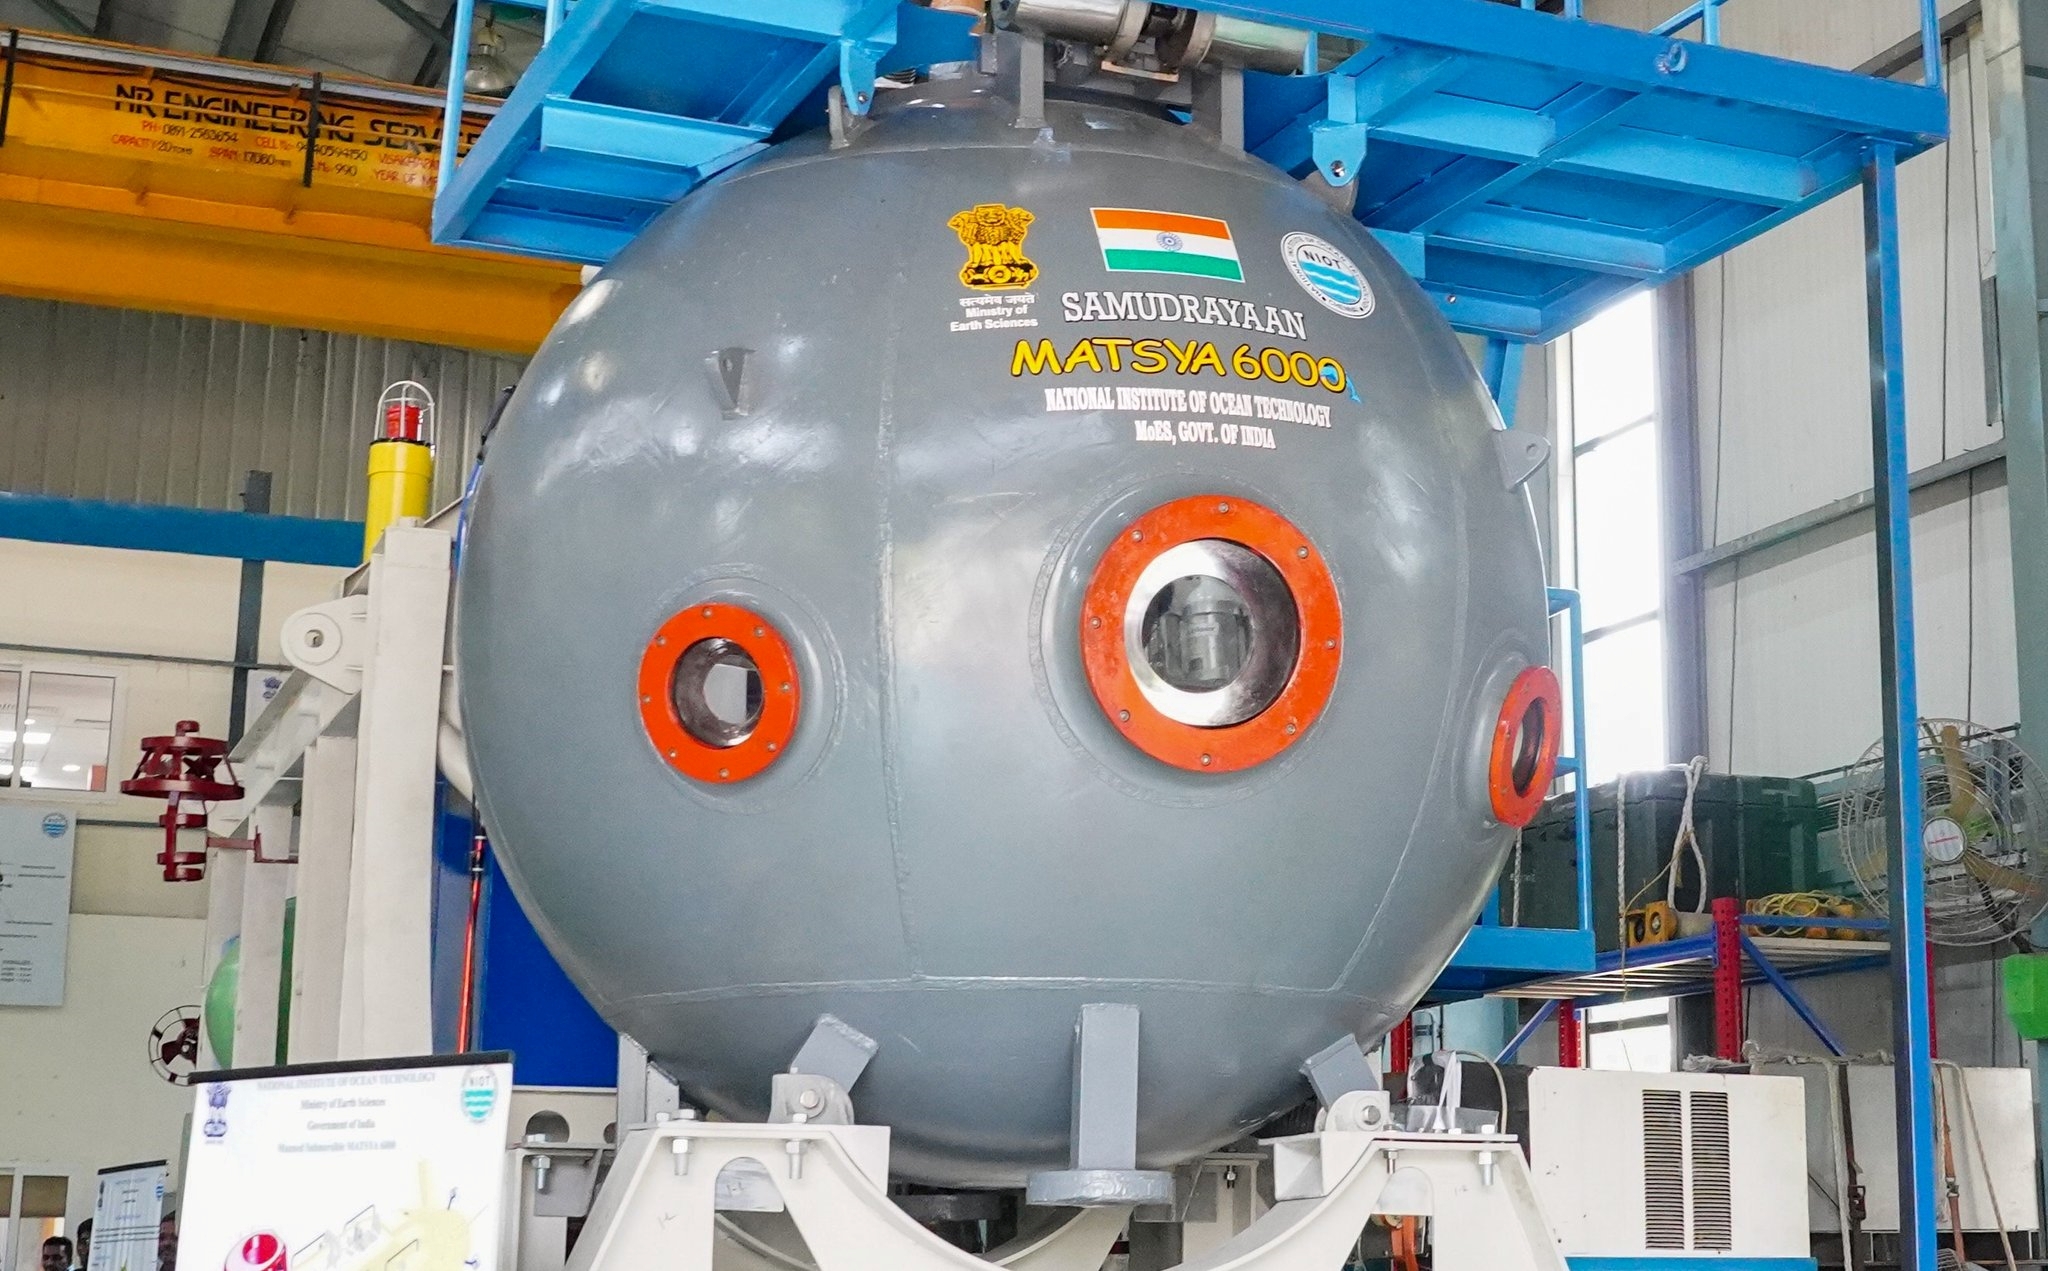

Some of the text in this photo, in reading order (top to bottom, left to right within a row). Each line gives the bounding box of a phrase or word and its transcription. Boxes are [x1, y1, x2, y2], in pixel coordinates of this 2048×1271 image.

[115, 84, 157, 118] NR
[1303, 250, 1341, 269] NIOT
[950, 318, 1038, 332] Earth Sciences
[965, 304, 1028, 318] Ministry of
[1061, 291, 1307, 340] SAMUDRAYAAN
[1010, 338, 1347, 392] MATSYA 6000
[1044, 387, 1332, 429] NATIONAL INSTITUTE OF OCEAN TECHNOLOGY
[1134, 420, 1277, 450] MoES, GOVT. OF INDIA
